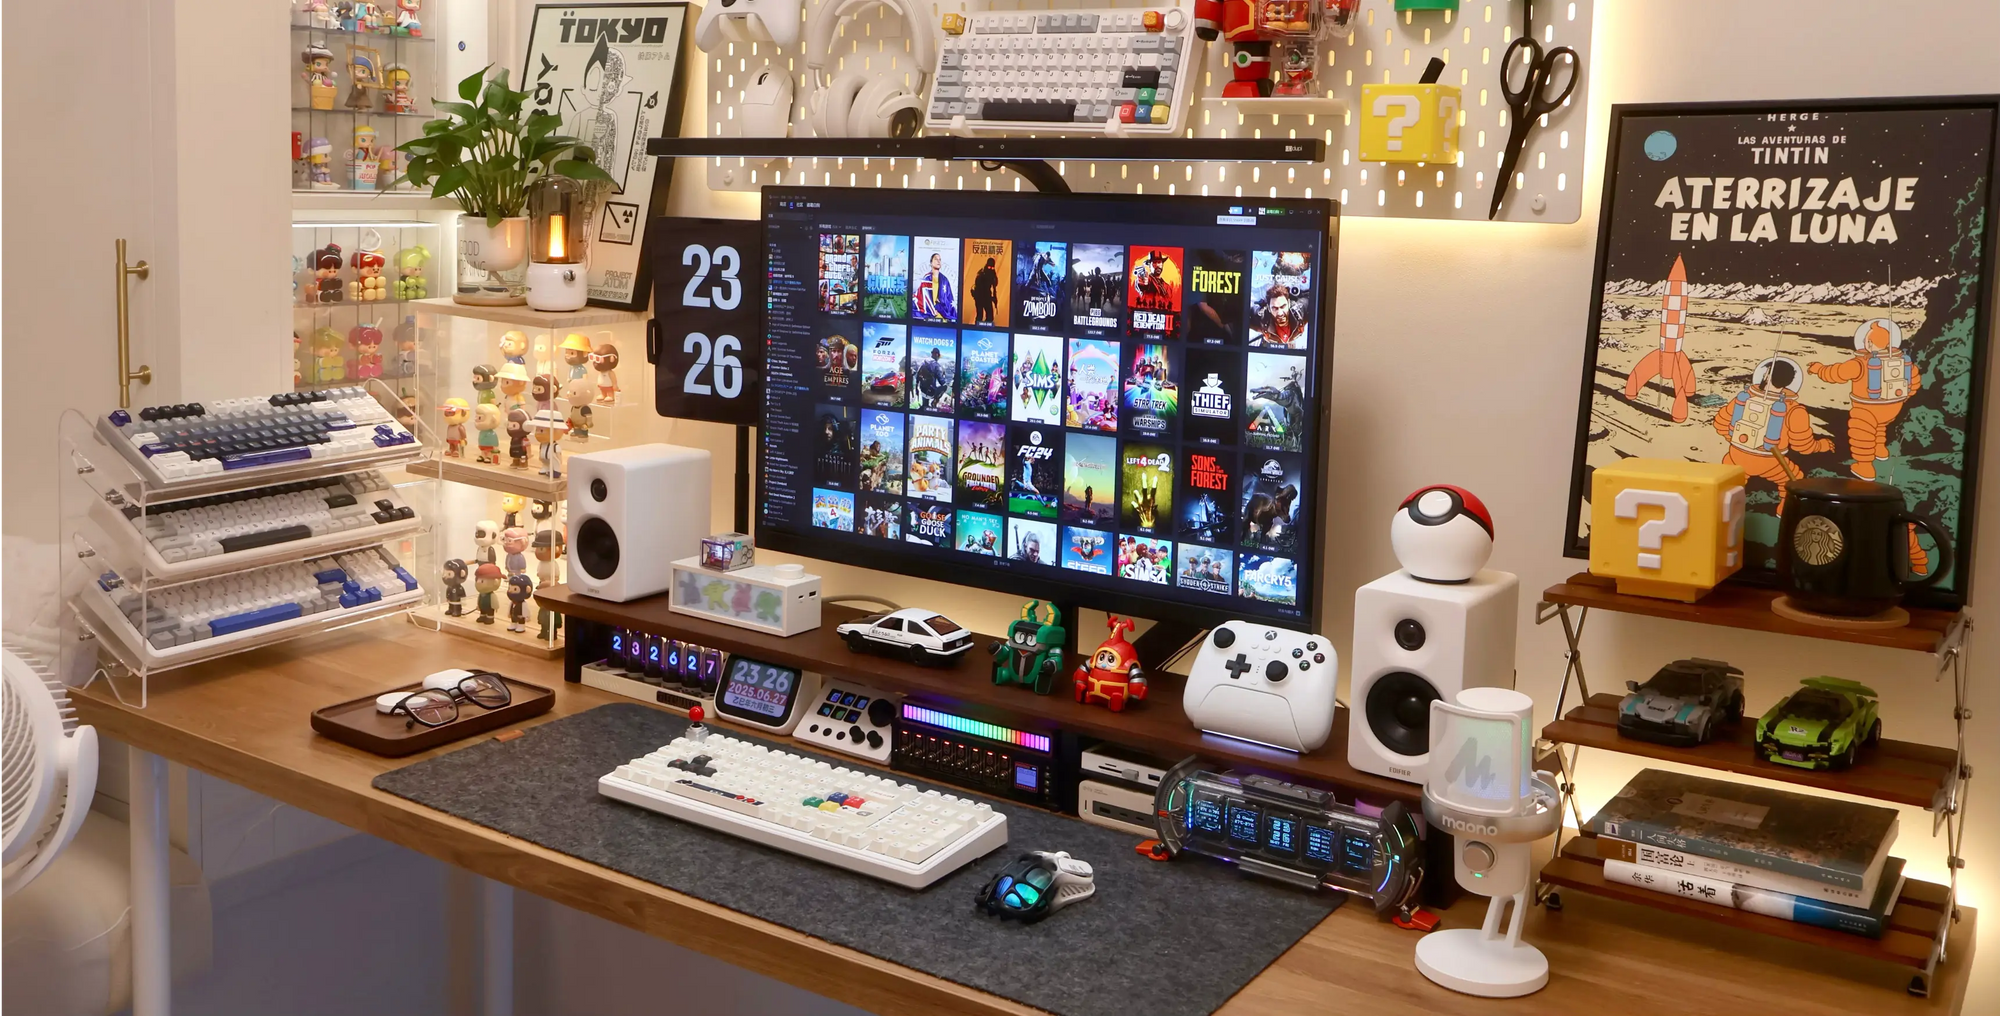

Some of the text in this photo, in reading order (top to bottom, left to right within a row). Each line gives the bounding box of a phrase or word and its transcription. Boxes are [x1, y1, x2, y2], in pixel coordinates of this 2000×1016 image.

[1767, 112, 1821, 122] HERGE
[1738, 135, 1847, 145] LAS AVENTURAS DE
[1751, 147, 1829, 165] TINTIN
[1654, 176, 1919, 212] ATERRIZAJE
[1670, 212, 1898, 245] EN LA LUNA
[682, 244, 742, 310] 23
[867, 275, 905, 288] CITIES
[1192, 270, 1241, 294] FOREST
[1023, 300, 1056, 318] ZOMBOID
[1073, 315, 1118, 328] BATTLEGROUNDS
[914, 337, 933, 345] WATCH
[933, 338, 949, 346] DOGS
[970, 356, 999, 364] COASTER
[972, 350, 999, 358] PLANET
[683, 332, 743, 398] 26
[824, 376, 849, 384] EMPIRES
[1026, 371, 1055, 388] SIMS
[1134, 398, 1167, 410] STAR TREK
[1194, 394, 1230, 409] THIEF
[1194, 407, 1228, 416] SIMULATOR
[870, 424, 895, 432] PLANET
[916, 425, 947, 439] PARTY
[911, 437, 950, 453] ANIMALS
[1126, 457, 1140, 465] LEFT
[1157, 453, 1170, 472] 2
[1191, 454, 1216, 472] SONS
[962, 472, 1000, 484] GROUNDED
[1191, 471, 1228, 490] FOREST
[920, 511, 946, 521] GOOSE
[921, 518, 944, 528] GOOSE
[919, 525, 946, 538] DUCK
[1210, 581, 1229, 591] STRIKE
[613, 636, 715, 674] 2 3 2 6 2 7
[734, 661, 789, 692] 23 26
[728, 682, 787, 705] 2025.06.27
[1389, 766, 1411, 776] EDIFIER
[1442, 814, 1498, 836] maono
[1641, 848, 1684, 867] 国富论
[1677, 880, 1716, 899] 活着
